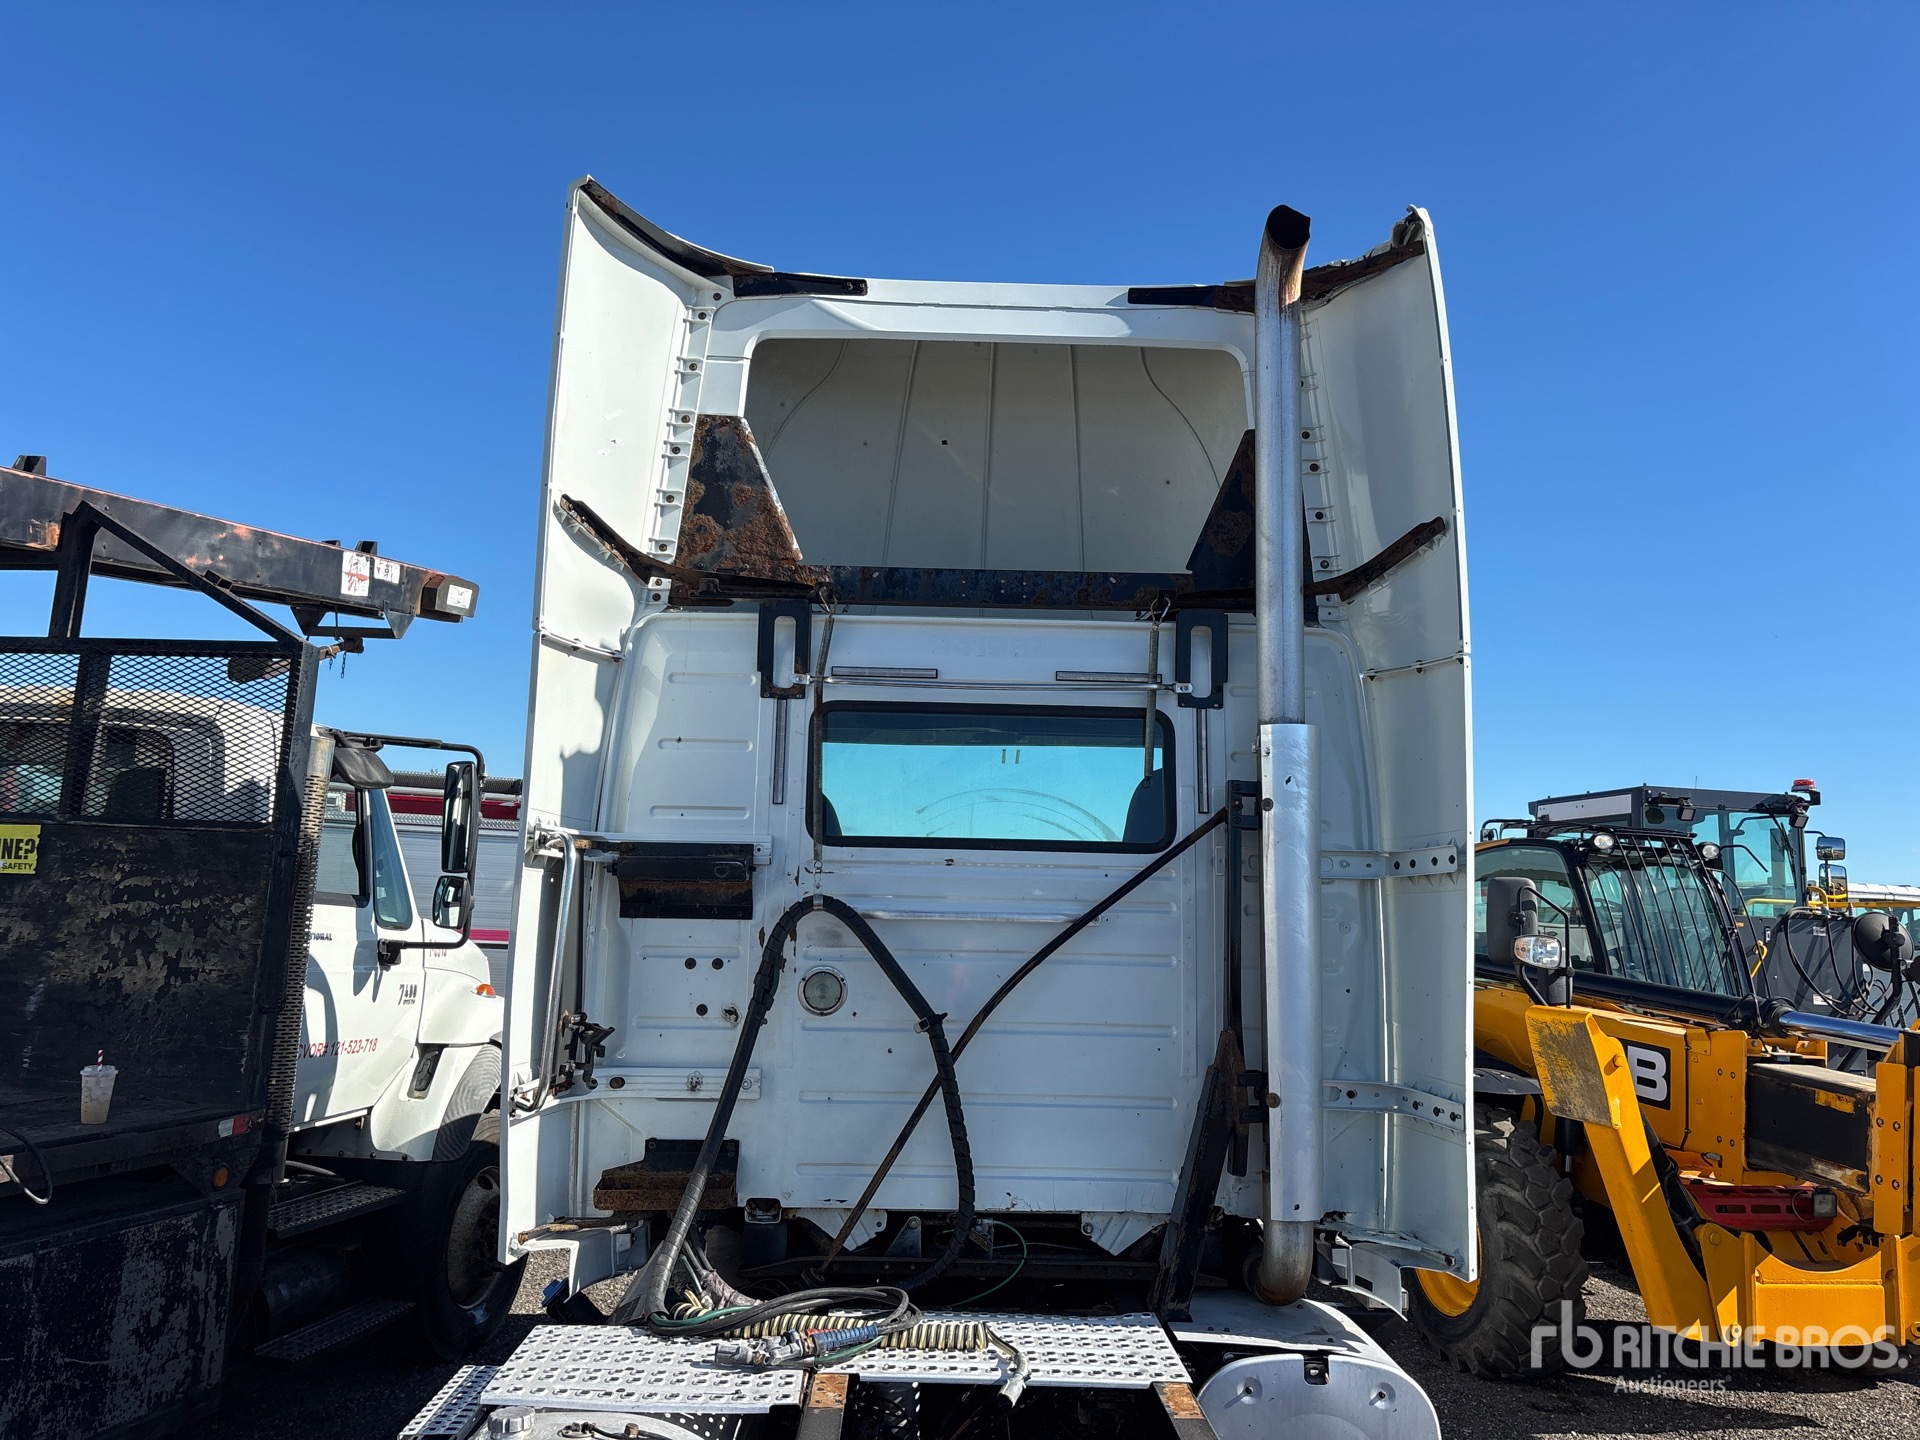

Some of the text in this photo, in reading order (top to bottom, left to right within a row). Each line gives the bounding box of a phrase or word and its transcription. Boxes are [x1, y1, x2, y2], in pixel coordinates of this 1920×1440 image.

[0, 838, 36, 860] NE?
[2, 862, 33, 870] SAFETY
[298, 1038, 378, 1059] CVOR# 121-523-718
